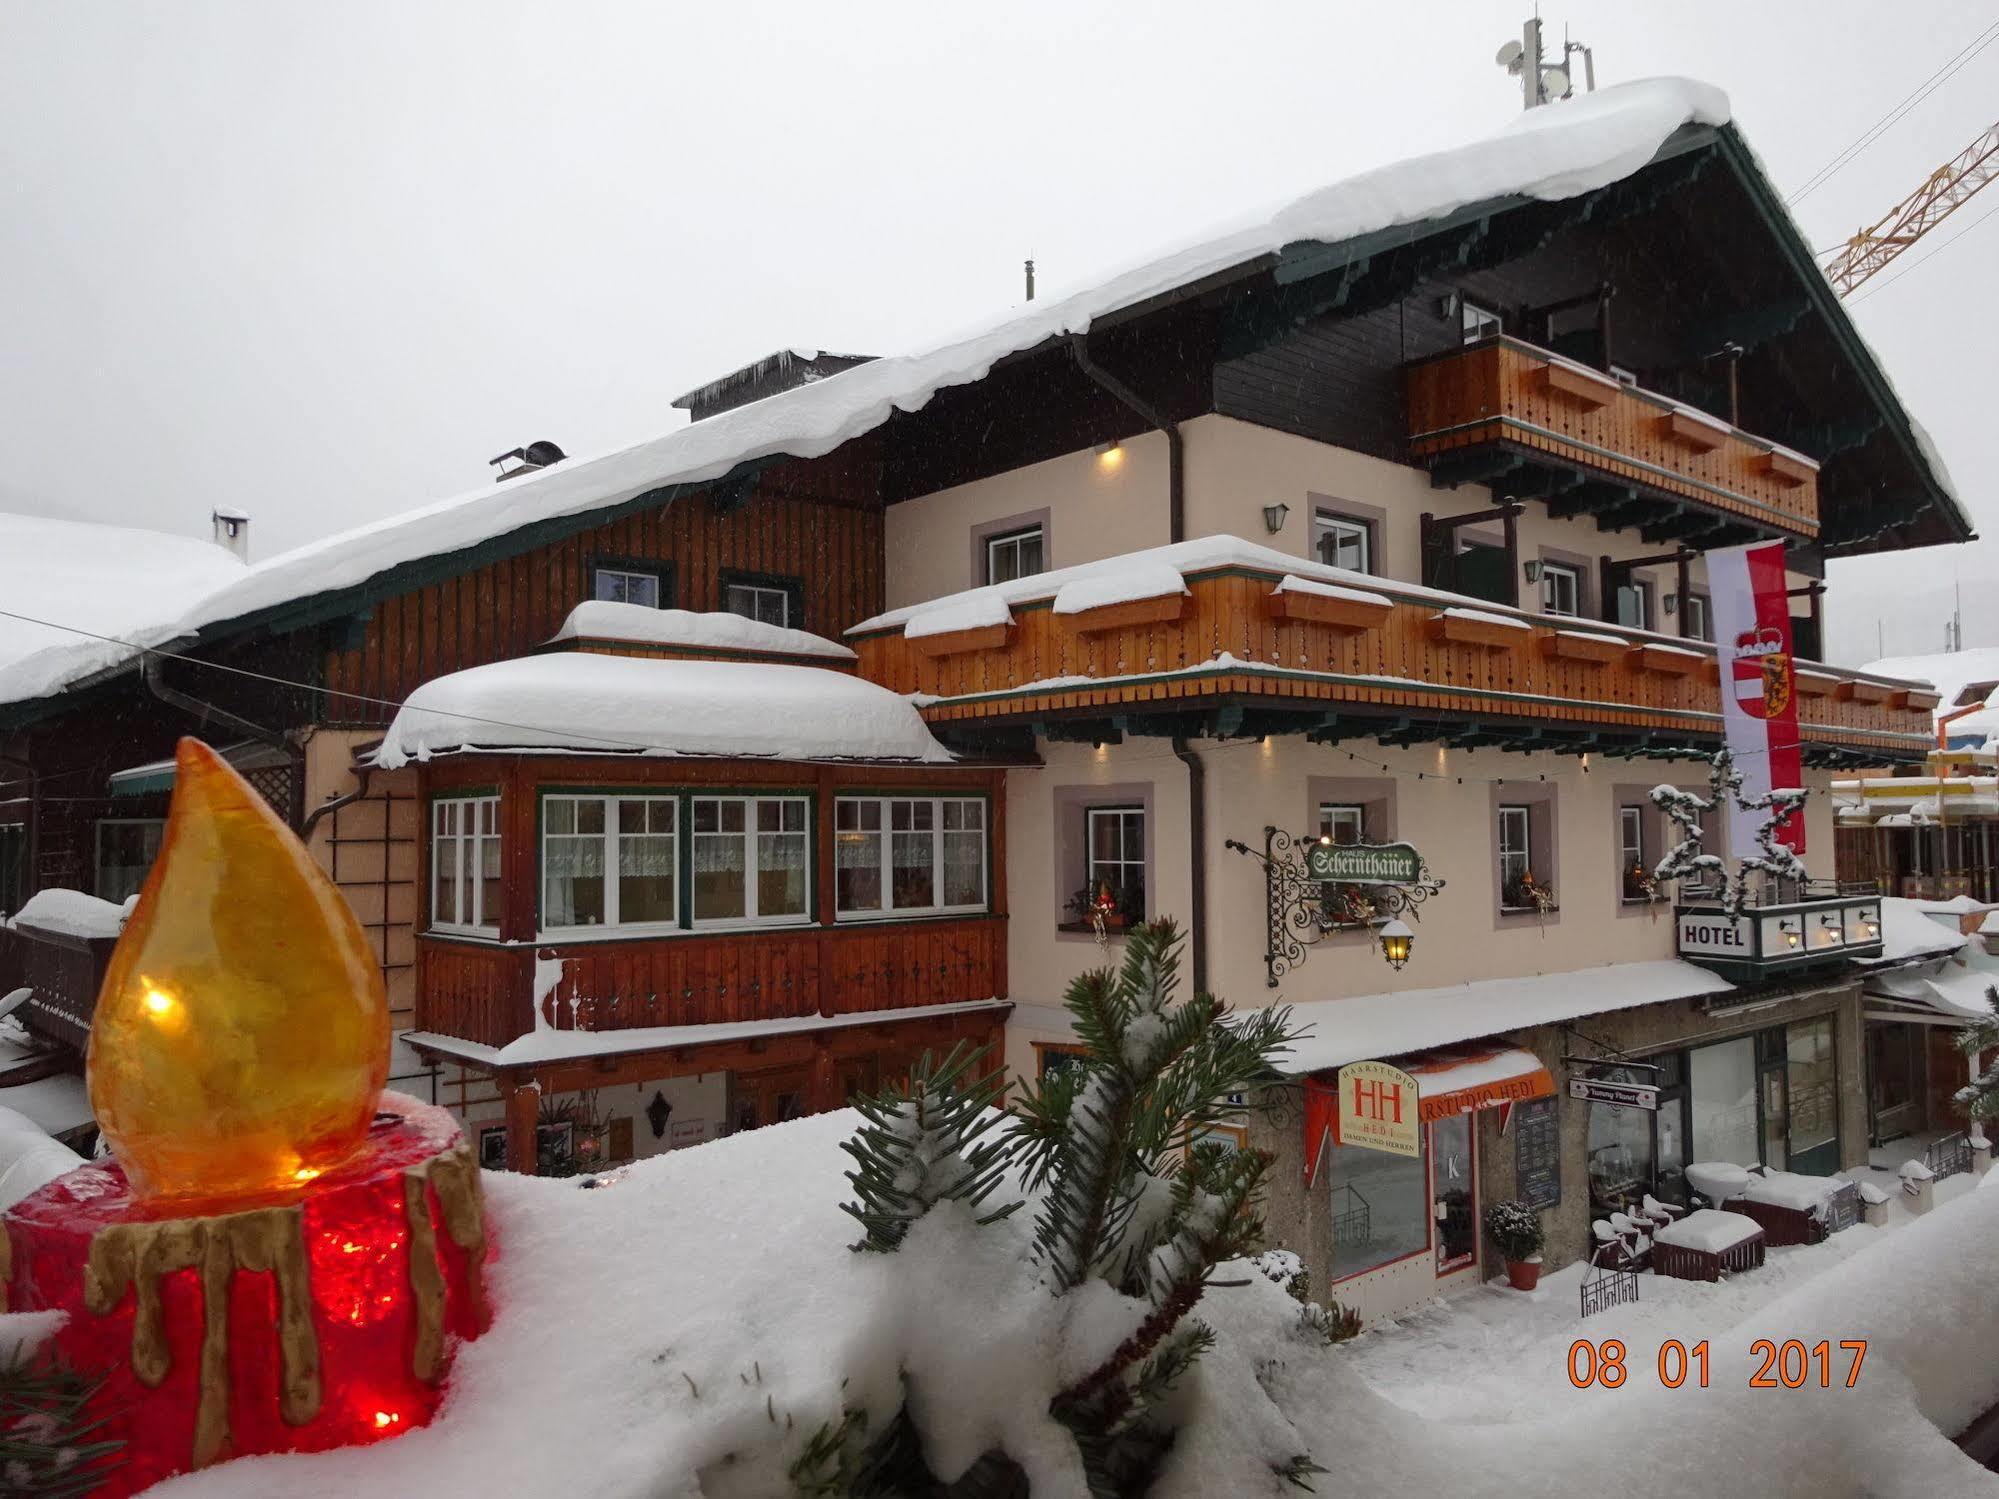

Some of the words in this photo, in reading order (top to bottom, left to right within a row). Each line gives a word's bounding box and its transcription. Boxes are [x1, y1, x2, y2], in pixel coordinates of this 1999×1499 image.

[1313, 850, 1412, 879] Schernthaner
[1685, 924, 1744, 946] HOTEL
[1342, 1064, 1415, 1090] HAARSTUDIO
[1353, 1077, 1402, 1124] HH
[1500, 1079, 1535, 1100] HEDI
[1363, 1122, 1394, 1138] HEDI
[1369, 1137, 1385, 1145] UND
[1385, 1140, 1415, 1152] HERREN
